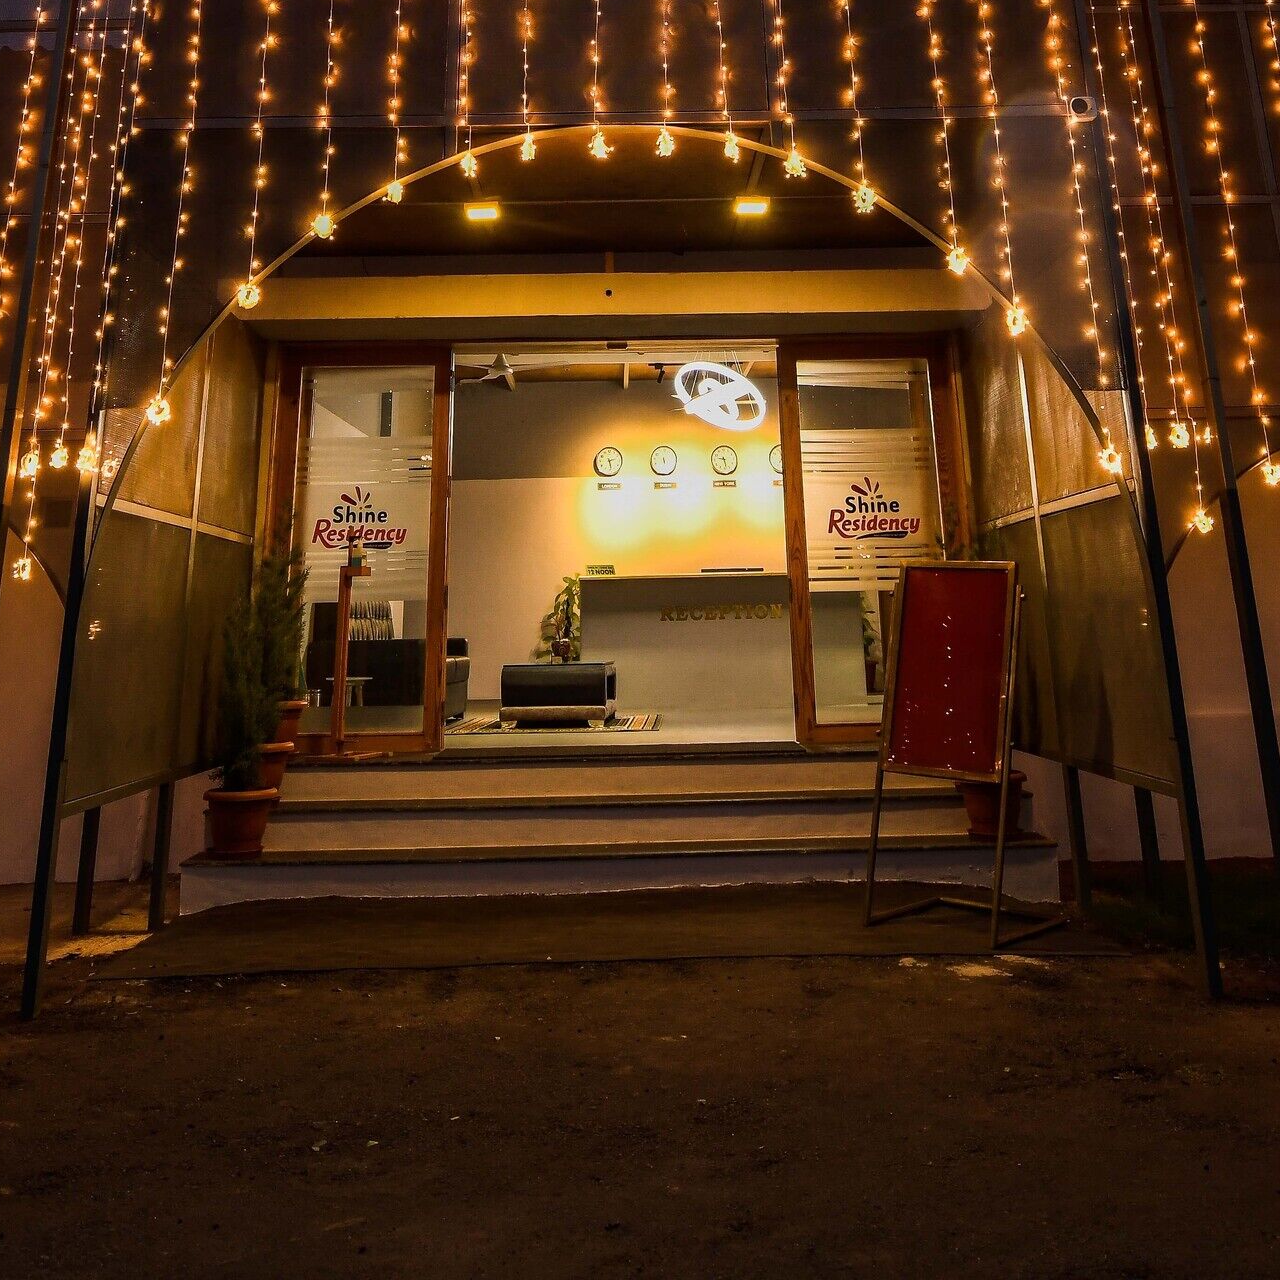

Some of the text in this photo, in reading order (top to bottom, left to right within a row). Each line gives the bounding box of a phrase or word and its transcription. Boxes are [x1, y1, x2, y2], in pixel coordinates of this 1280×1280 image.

[332, 505, 388, 523] Shine
[845, 495, 900, 514] Shine
[828, 509, 921, 539] Residency
[660, 603, 783, 622] RECEPTION
